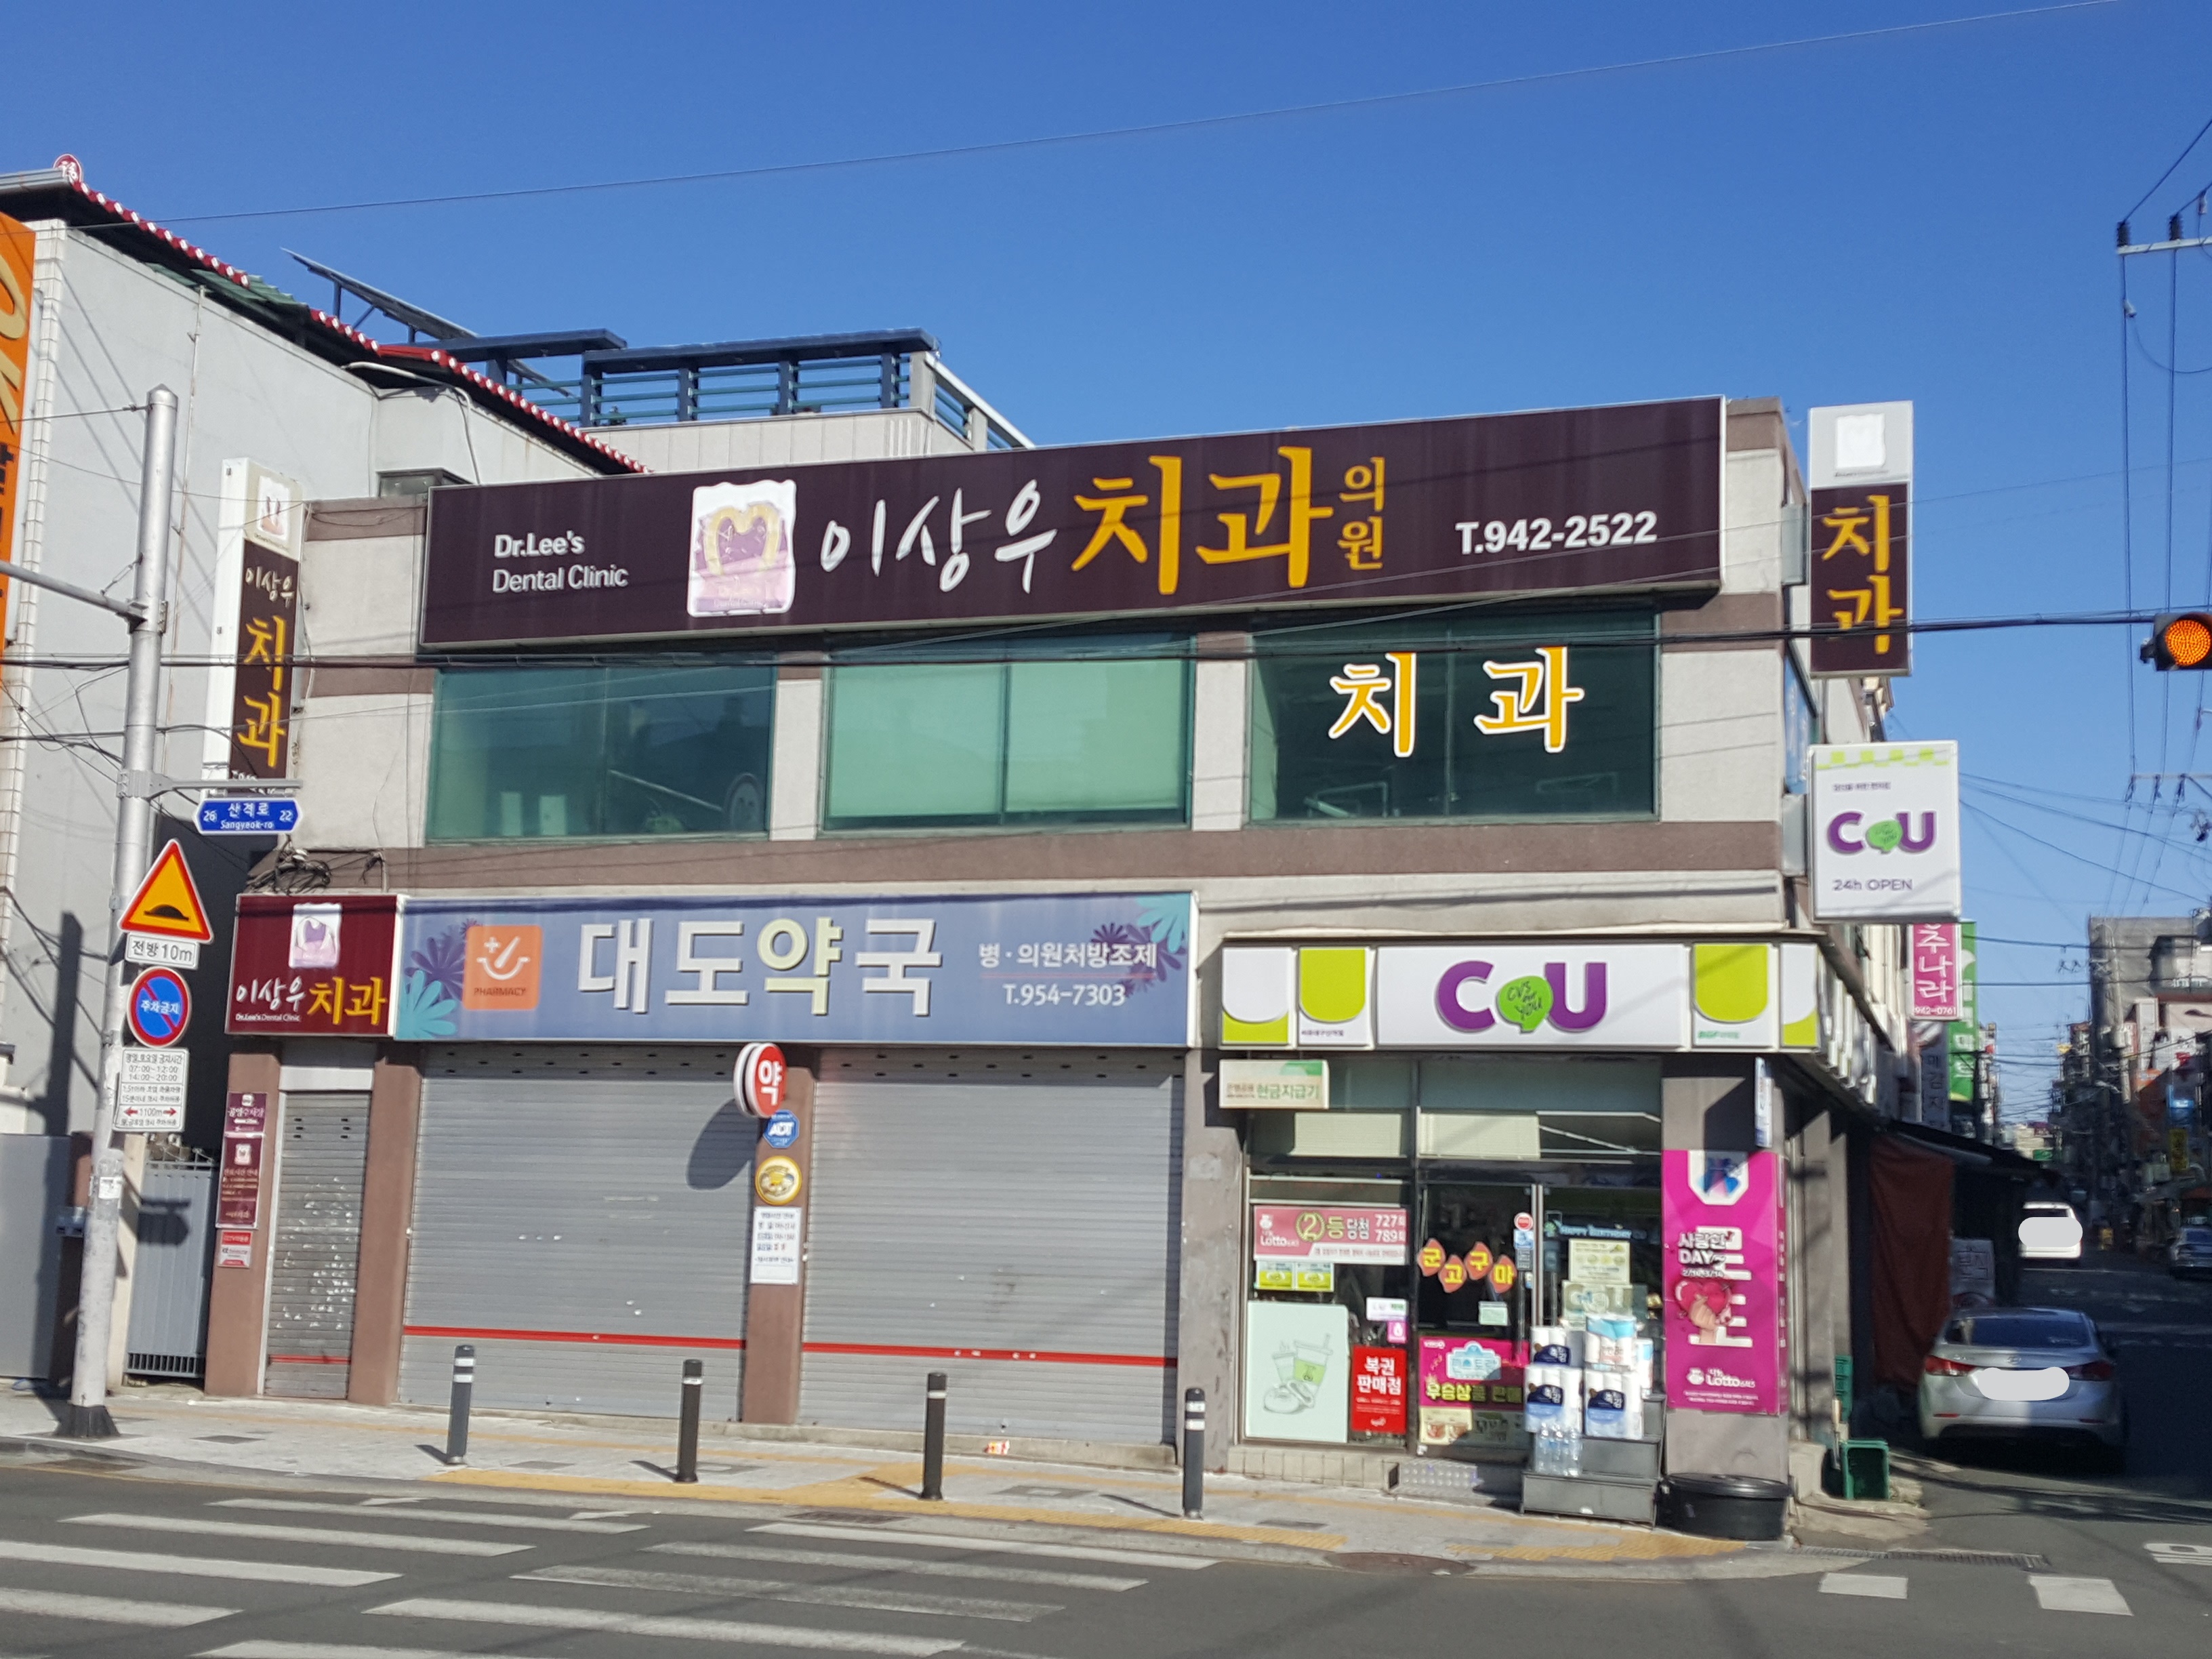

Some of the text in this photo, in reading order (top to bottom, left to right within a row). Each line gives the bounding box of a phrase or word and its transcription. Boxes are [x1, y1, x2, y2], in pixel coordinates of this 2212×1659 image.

[821, 446, 1385, 595] 이상우 치과 의원
[1456, 511, 1658, 554] T.942-2522
[494, 531, 584, 558] Dr.Lee's
[245, 565, 295, 608] 이상우
[492, 564, 629, 594] Dental Clinic
[1822, 495, 1903, 654] 치과
[237, 615, 286, 768] 치과
[1328, 646, 1584, 758] 치과
[203, 802, 293, 822] 26 산격로 22
[220, 818, 274, 830] Sangyeok-ro
[1826, 811, 1937, 855] CU
[1833, 878, 1913, 891] 24h OPEN
[132, 940, 192, 962] 전방 10m
[1916, 924, 1954, 1003] 주나라
[578, 918, 942, 1017] 대도약국
[237, 976, 387, 1025] 이상우 치과
[474, 987, 527, 997] PHARMACY
[1003, 983, 1126, 1006] T.954-7303
[1435, 960, 1607, 1033] CU
[141, 1000, 180, 1015] 주차금지
[1916, 1006, 1957, 1015] 942-0761
[758, 1060, 783, 1107] 약
[768, 1122, 795, 1136] ADT
[1347, 1218, 1370, 1240] 당첨
[1365, 1356, 1395, 1376] 복권
[1357, 1375, 1401, 1395] 판매점
[1706, 1374, 1740, 1387] Lotto
